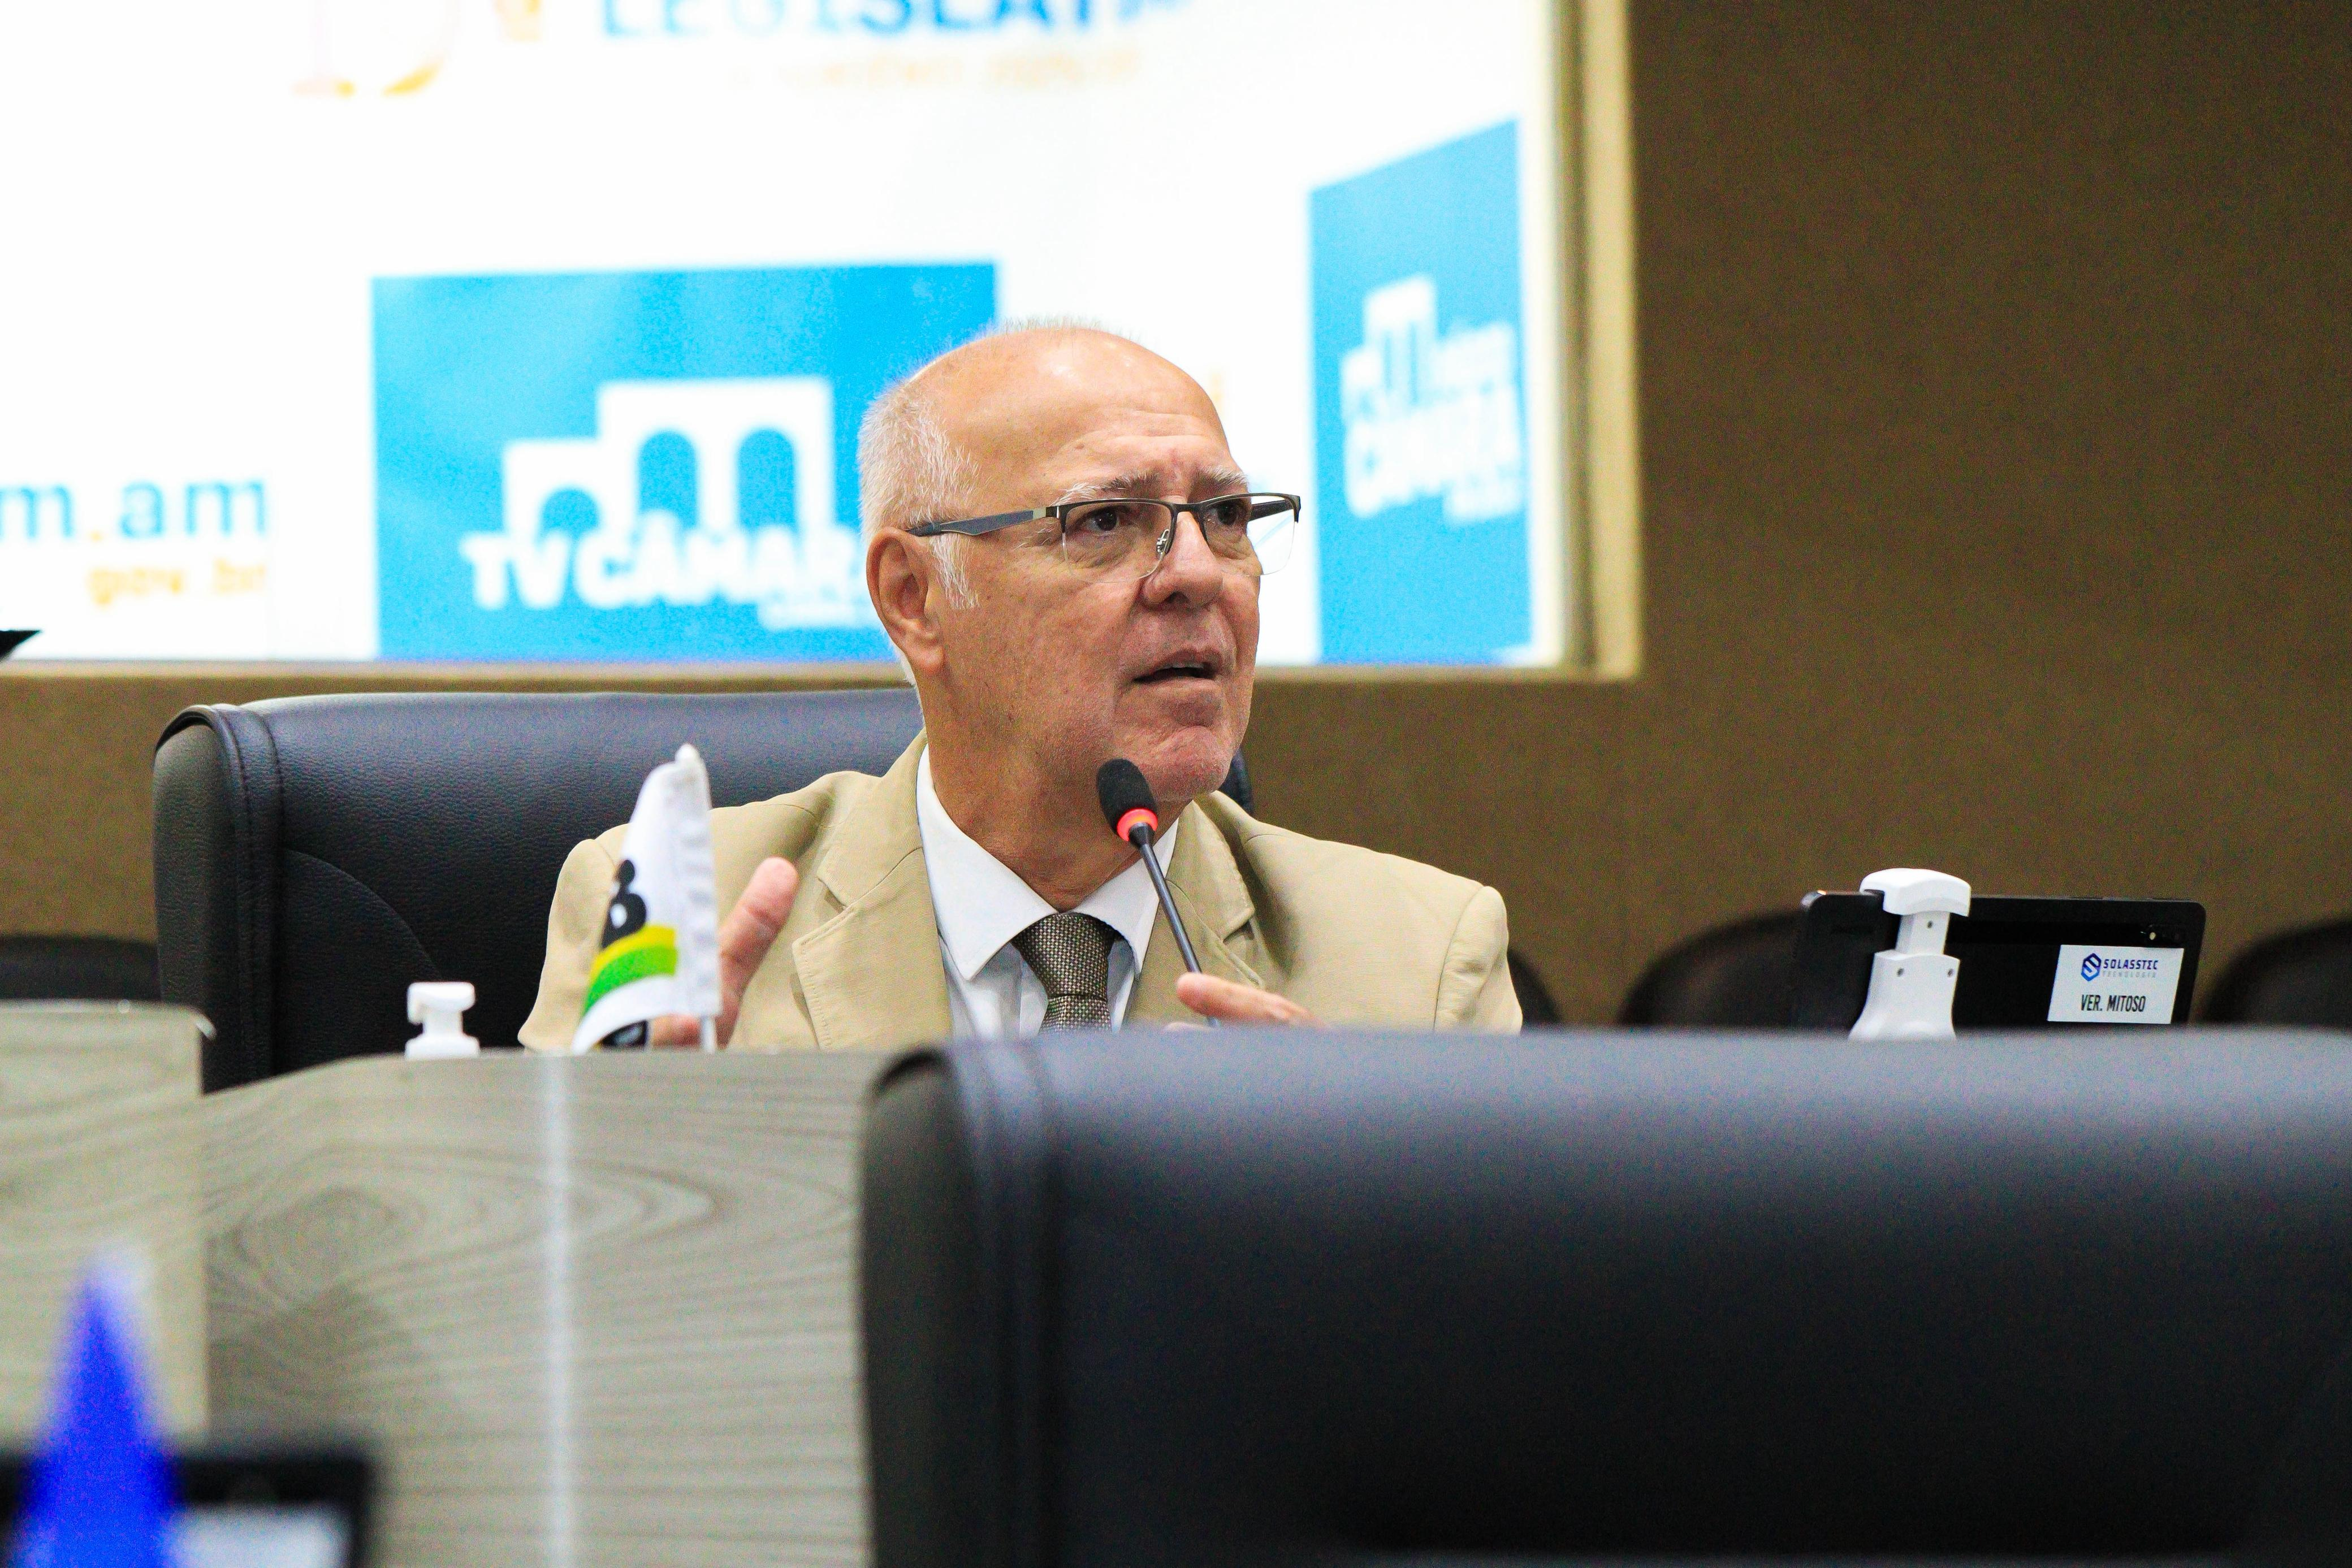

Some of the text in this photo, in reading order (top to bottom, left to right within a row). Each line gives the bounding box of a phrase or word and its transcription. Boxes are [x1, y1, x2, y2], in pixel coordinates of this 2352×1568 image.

[460, 512, 868, 608] TV CÂMAR
[2081, 994, 2146, 1012] VER. MITOSO
